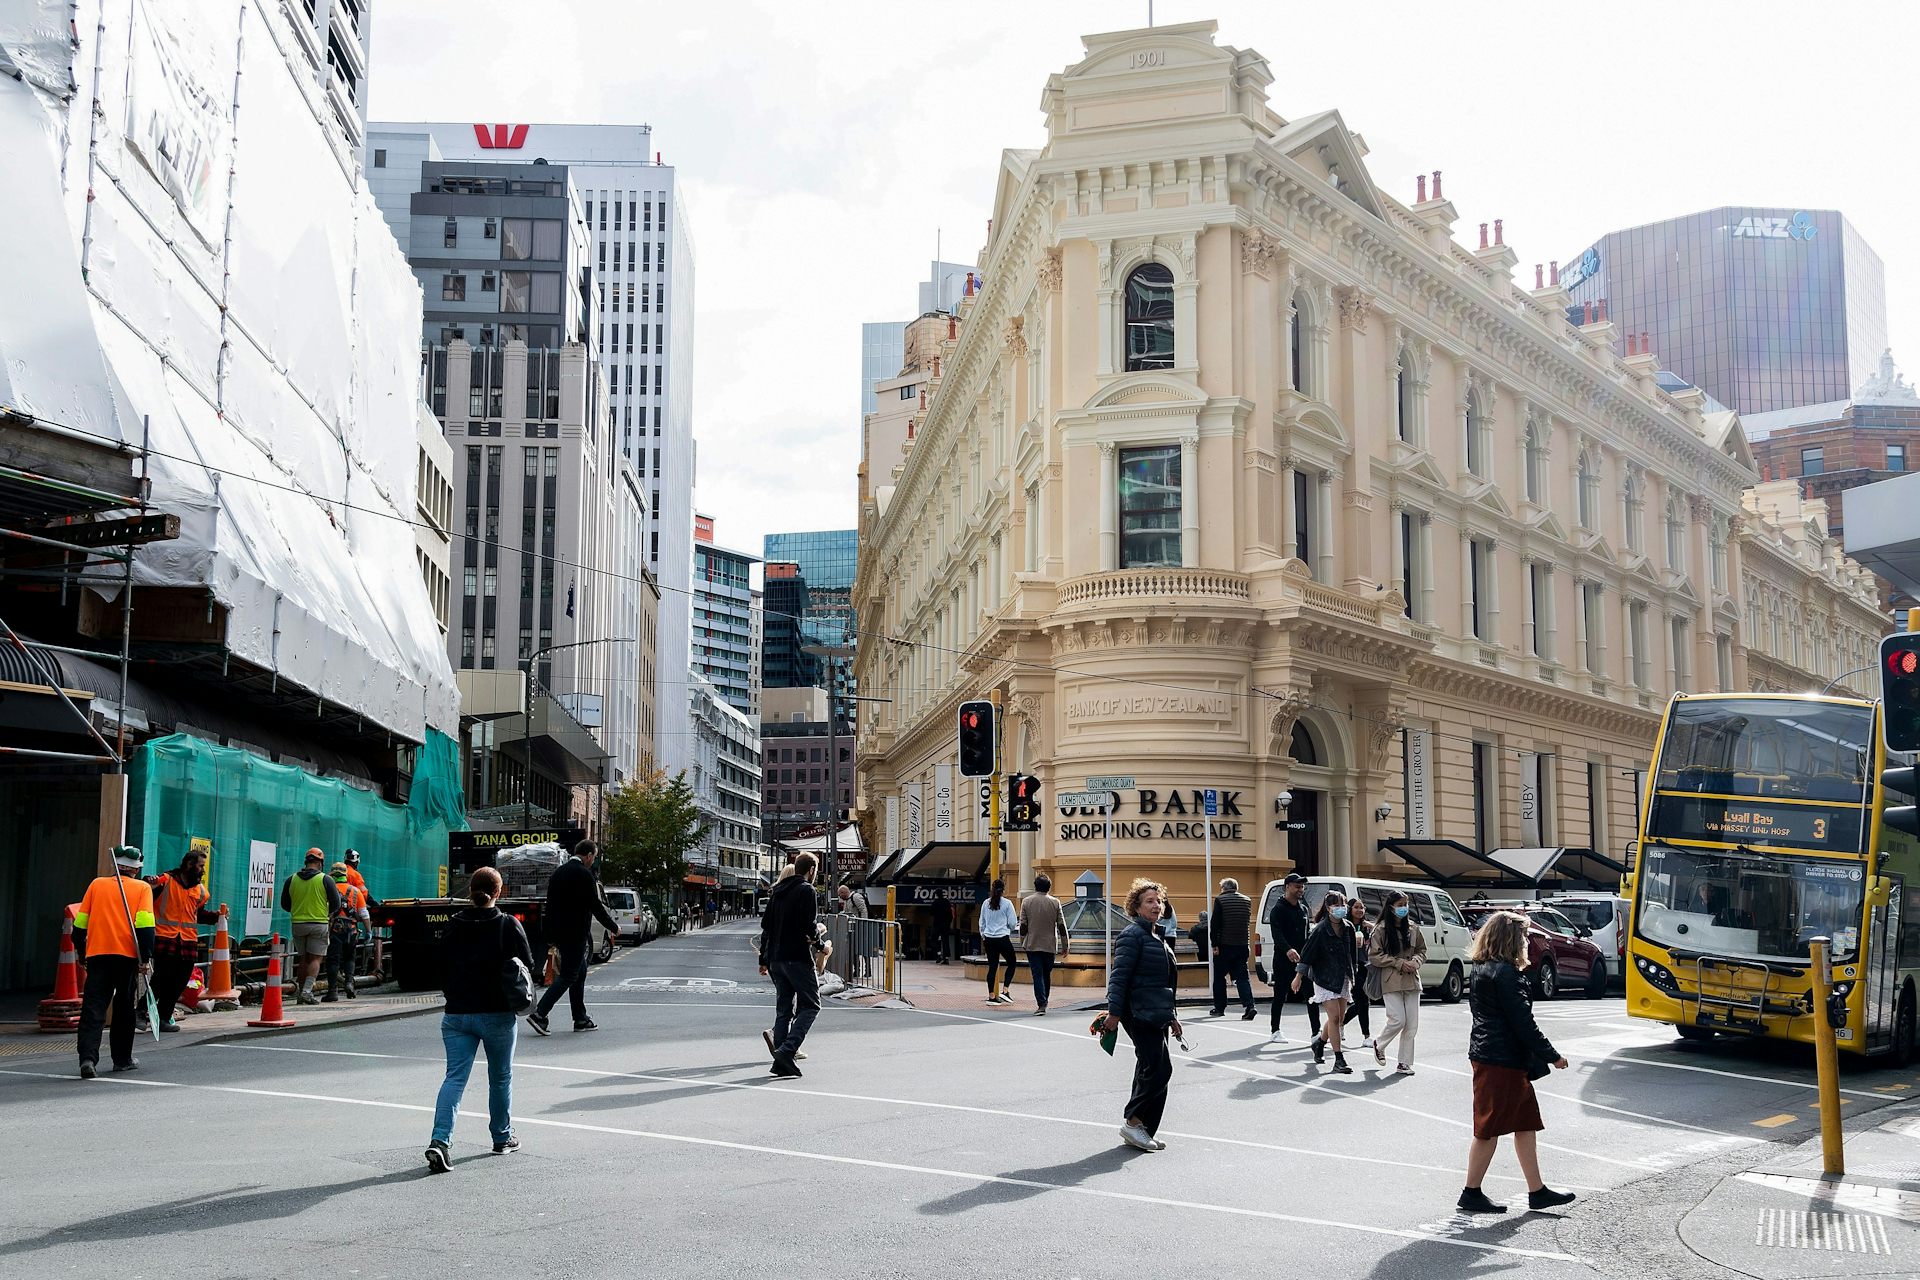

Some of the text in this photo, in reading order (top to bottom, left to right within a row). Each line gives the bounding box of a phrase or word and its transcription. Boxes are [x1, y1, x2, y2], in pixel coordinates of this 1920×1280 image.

[1130, 50, 1165, 69] 1901
[1734, 217, 1788, 238] ANZ
[1069, 700, 1101, 718] BANK
[1101, 699, 1121, 714] OF
[1122, 698, 1156, 713] NEW
[1088, 776, 1132, 790] CUSTOMHOUSE QUAY
[1412, 734, 1425, 835] SMITH THE GROCER
[937, 787, 950, 799] Co
[1061, 794, 1102, 805] LAMBTON QUAY
[1138, 789, 1242, 816] BANK
[1522, 783, 1534, 820] RUBY
[937, 808, 950, 828] Sills
[1724, 811, 1774, 826] Lyall Bay
[798, 827, 818, 838] OLD
[1060, 822, 1242, 840] SHOPPING ARCADE
[1720, 824, 1750, 833] MASSEY
[1813, 818, 1826, 839] 3
[474, 832, 559, 846] TANA GROUP
[250, 861, 274, 884] McKEE
[249, 887, 267, 909] FEHL
[426, 914, 449, 923] TANA
